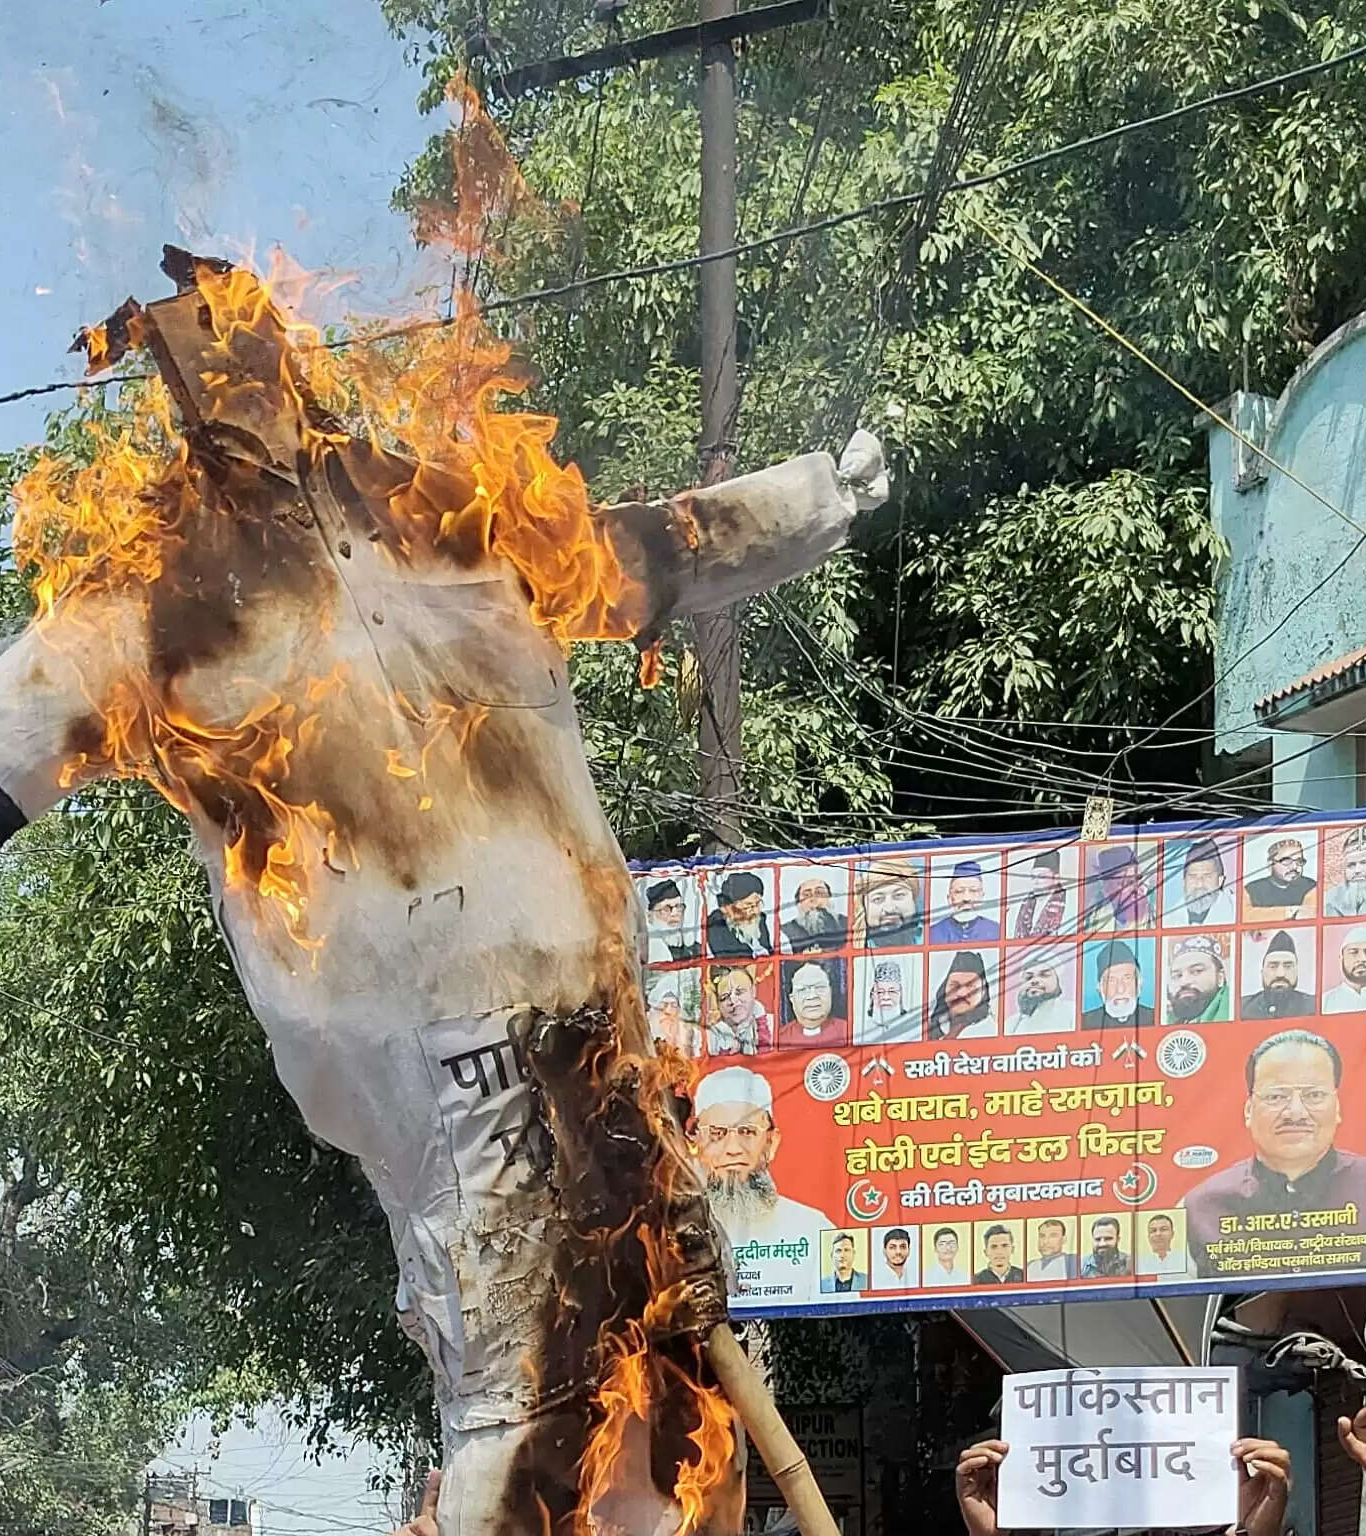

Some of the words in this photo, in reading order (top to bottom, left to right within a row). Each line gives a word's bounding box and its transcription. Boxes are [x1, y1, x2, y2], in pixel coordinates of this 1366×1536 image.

[904, 1053, 949, 1079] सभी
[953, 1052, 988, 1075] देश
[993, 1045, 1067, 1073] वासियों
[1071, 1042, 1101, 1069] को
[834, 1092, 881, 1126] शबे
[886, 1093, 977, 1122] बारात,
[985, 1082, 1045, 1117] माहे
[846, 1135, 918, 1175] होली
[919, 1135, 966, 1168] एवं
[968, 1130, 1014, 1169] ईद
[1017, 1134, 1070, 1162] उल
[1078, 1123, 1166, 1157] फितर
[900, 1181, 934, 1208] की
[934, 1182, 983, 1206] दिली
[987, 1178, 1103, 1213] मुबारकबाद
[1300, 1203, 1357, 1227] उस्मानी
[773, 1237, 809, 1265] मंसूरी
[1326, 1251, 1361, 1264] समाज
[763, 1286, 793, 1296] समाज
[1014, 1370, 1229, 1418] पाकिस्तान
[1030, 1427, 1196, 1498] मुर्दाबाद
